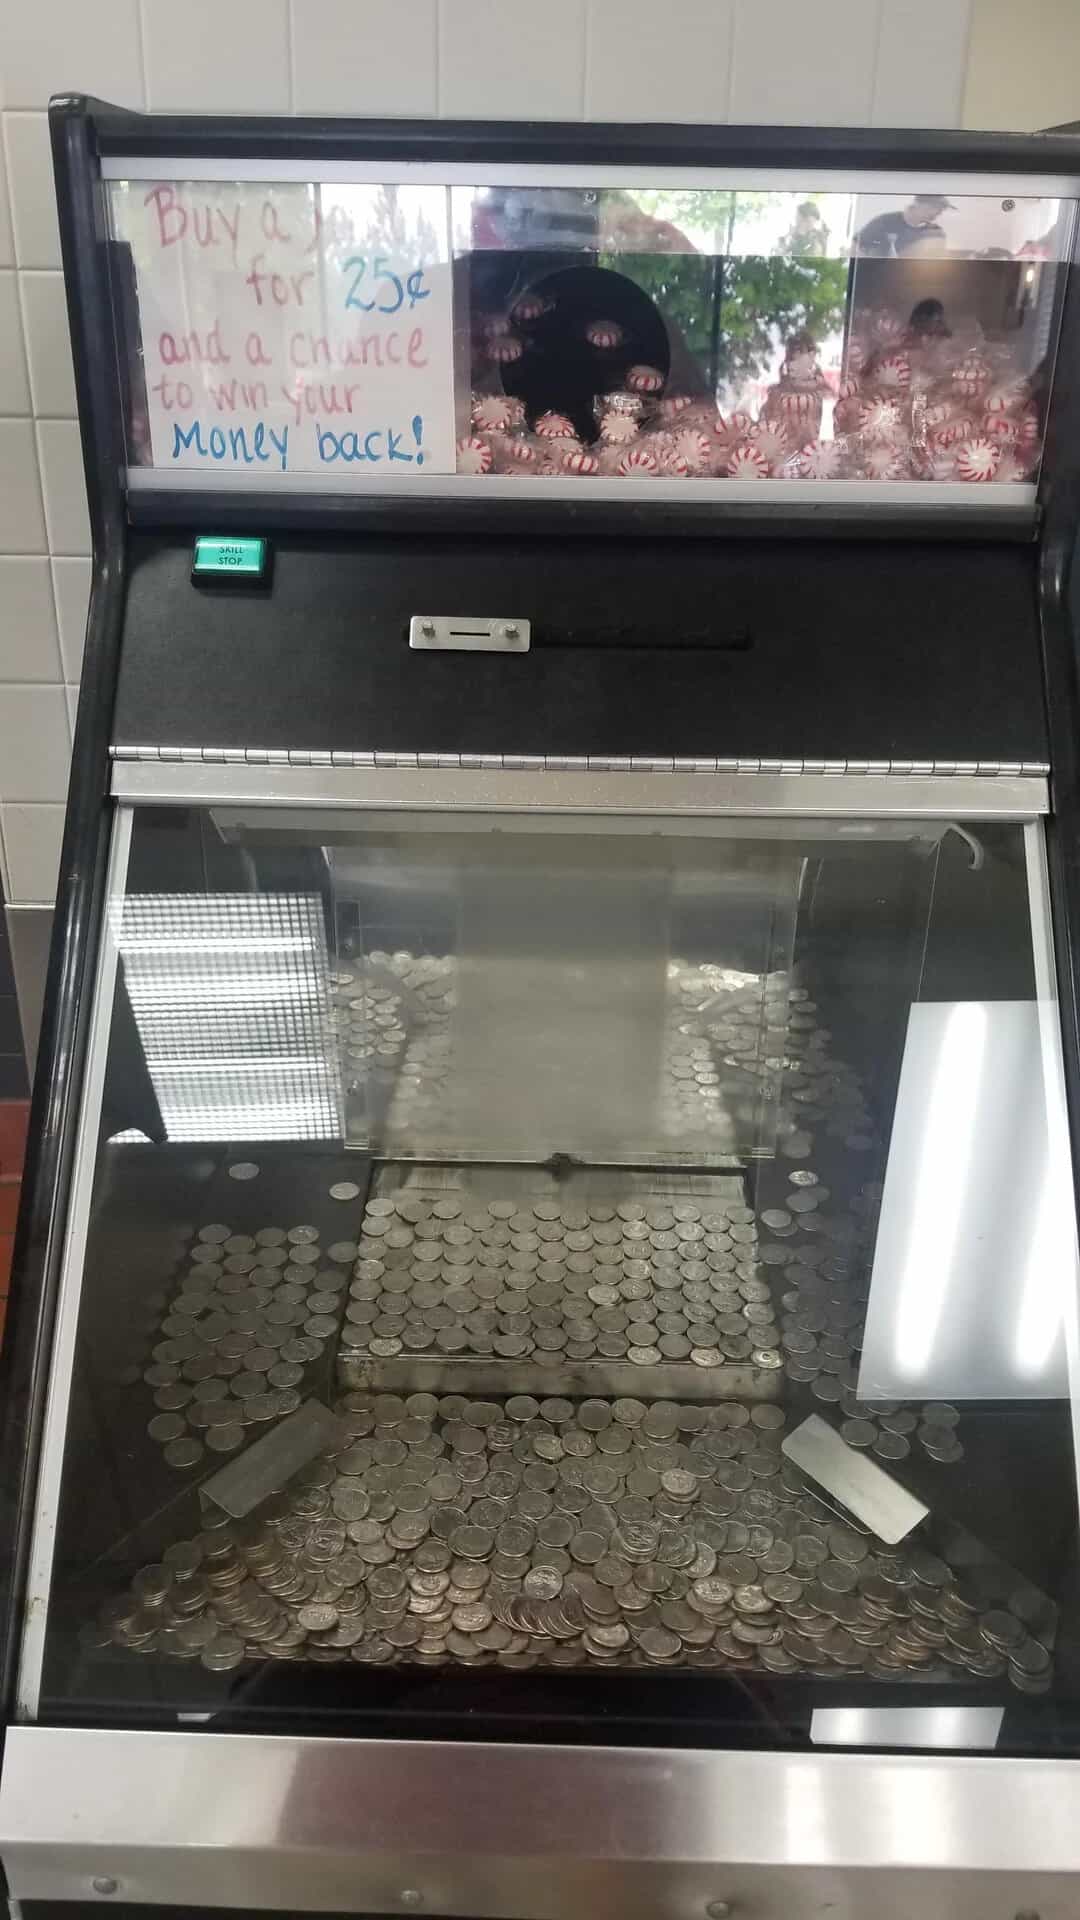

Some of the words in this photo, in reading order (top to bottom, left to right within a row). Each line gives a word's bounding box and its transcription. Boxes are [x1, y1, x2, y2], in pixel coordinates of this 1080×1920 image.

[143, 184, 241, 270] Buy
[261, 200, 291, 242] a
[246, 254, 314, 306] for
[158, 318, 231, 366] and
[245, 331, 272, 366] a
[152, 374, 193, 411] to
[212, 377, 268, 412] win
[280, 374, 361, 426] your
[172, 420, 289, 471] Money
[316, 414, 426, 466] back!
[218, 556, 243, 566] STOP
[219, 545, 244, 554] SKILL
